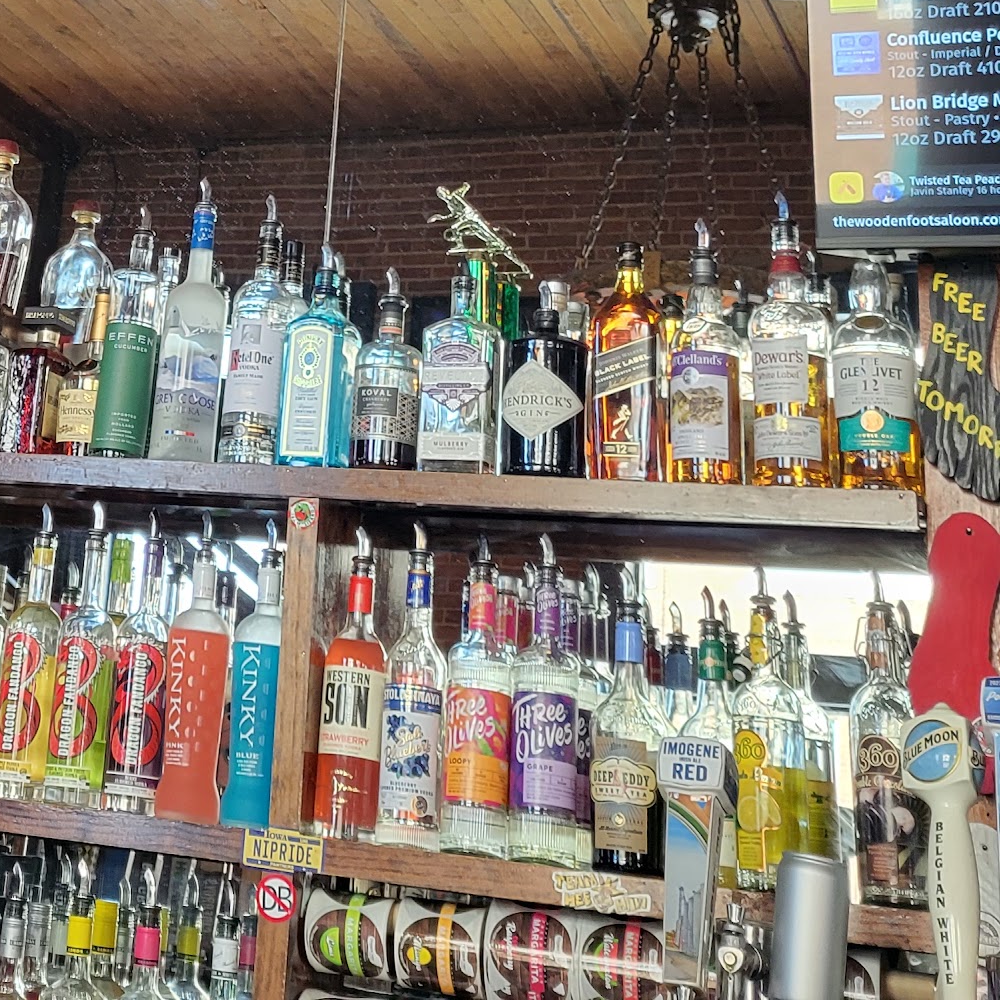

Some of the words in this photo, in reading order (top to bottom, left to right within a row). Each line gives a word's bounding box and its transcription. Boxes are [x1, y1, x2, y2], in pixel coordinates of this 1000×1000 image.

[927, 2, 970, 18] Draft
[886, 29, 982, 46] Confluence
[887, 50, 920, 61] Stout
[930, 46, 981, 60] Imperial
[888, 64, 926, 79] 12oz
[929, 61, 972, 77] Draft
[890, 94, 927, 111] Lion
[932, 92, 989, 112] Bridge
[891, 115, 931, 127] Stout
[944, 112, 991, 128] Pastry
[893, 132, 929, 147] 12oz
[933, 128, 977, 146] Draft
[909, 174, 951, 186] Twisted
[952, 174, 973, 186] Tea
[936, 186, 974, 198] Stanley
[976, 185, 988, 195] 16
[932, 272, 987, 322] FREE
[108, 331, 154, 347] EFFEN
[113, 343, 148, 354] CUCUMBER
[755, 350, 804, 367] Dewar's
[931, 322, 984, 376] BEER
[231, 349, 252, 371] Ketel
[254, 350, 273, 366] One
[594, 361, 622, 377] BLACK
[622, 353, 651, 368] LABEL
[673, 353, 723, 367] Clelland's
[860, 357, 880, 366] TE
[776, 369, 801, 380] Label
[361, 387, 393, 398] KOVAL
[862, 379, 880, 392] 12
[520, 409, 543, 417] GIN
[616, 444, 628, 454] 12
[8, 641, 24, 703] FANDANGO
[64, 645, 80, 707] FANDANGO
[327, 669, 372, 686] WESTERN
[132, 651, 150, 714] FANDANGO
[168, 637, 188, 739] KINKY
[239, 644, 262, 748] KINKY
[323, 682, 370, 730] SON
[2, 704, 17, 751] DRAGON
[57, 708, 73, 758] DRAGON
[126, 714, 141, 766] DRAGON
[903, 741, 924, 762] BLUE
[923, 729, 961, 751] MOON
[235, 751, 260, 761] BLUE
[663, 741, 721, 760] IMOGENE
[858, 742, 899, 772] 360
[526, 763, 554, 773] GRAPE
[672, 763, 709, 782] RED
[593, 769, 614, 783] DEEP
[622, 771, 650, 787] EDDY
[265, 831, 288, 842] IOWA
[252, 838, 313, 865] NIPRIDE
[934, 821, 947, 909] BELGIAN
[262, 885, 292, 912] DB
[937, 917, 955, 986] WHITE
